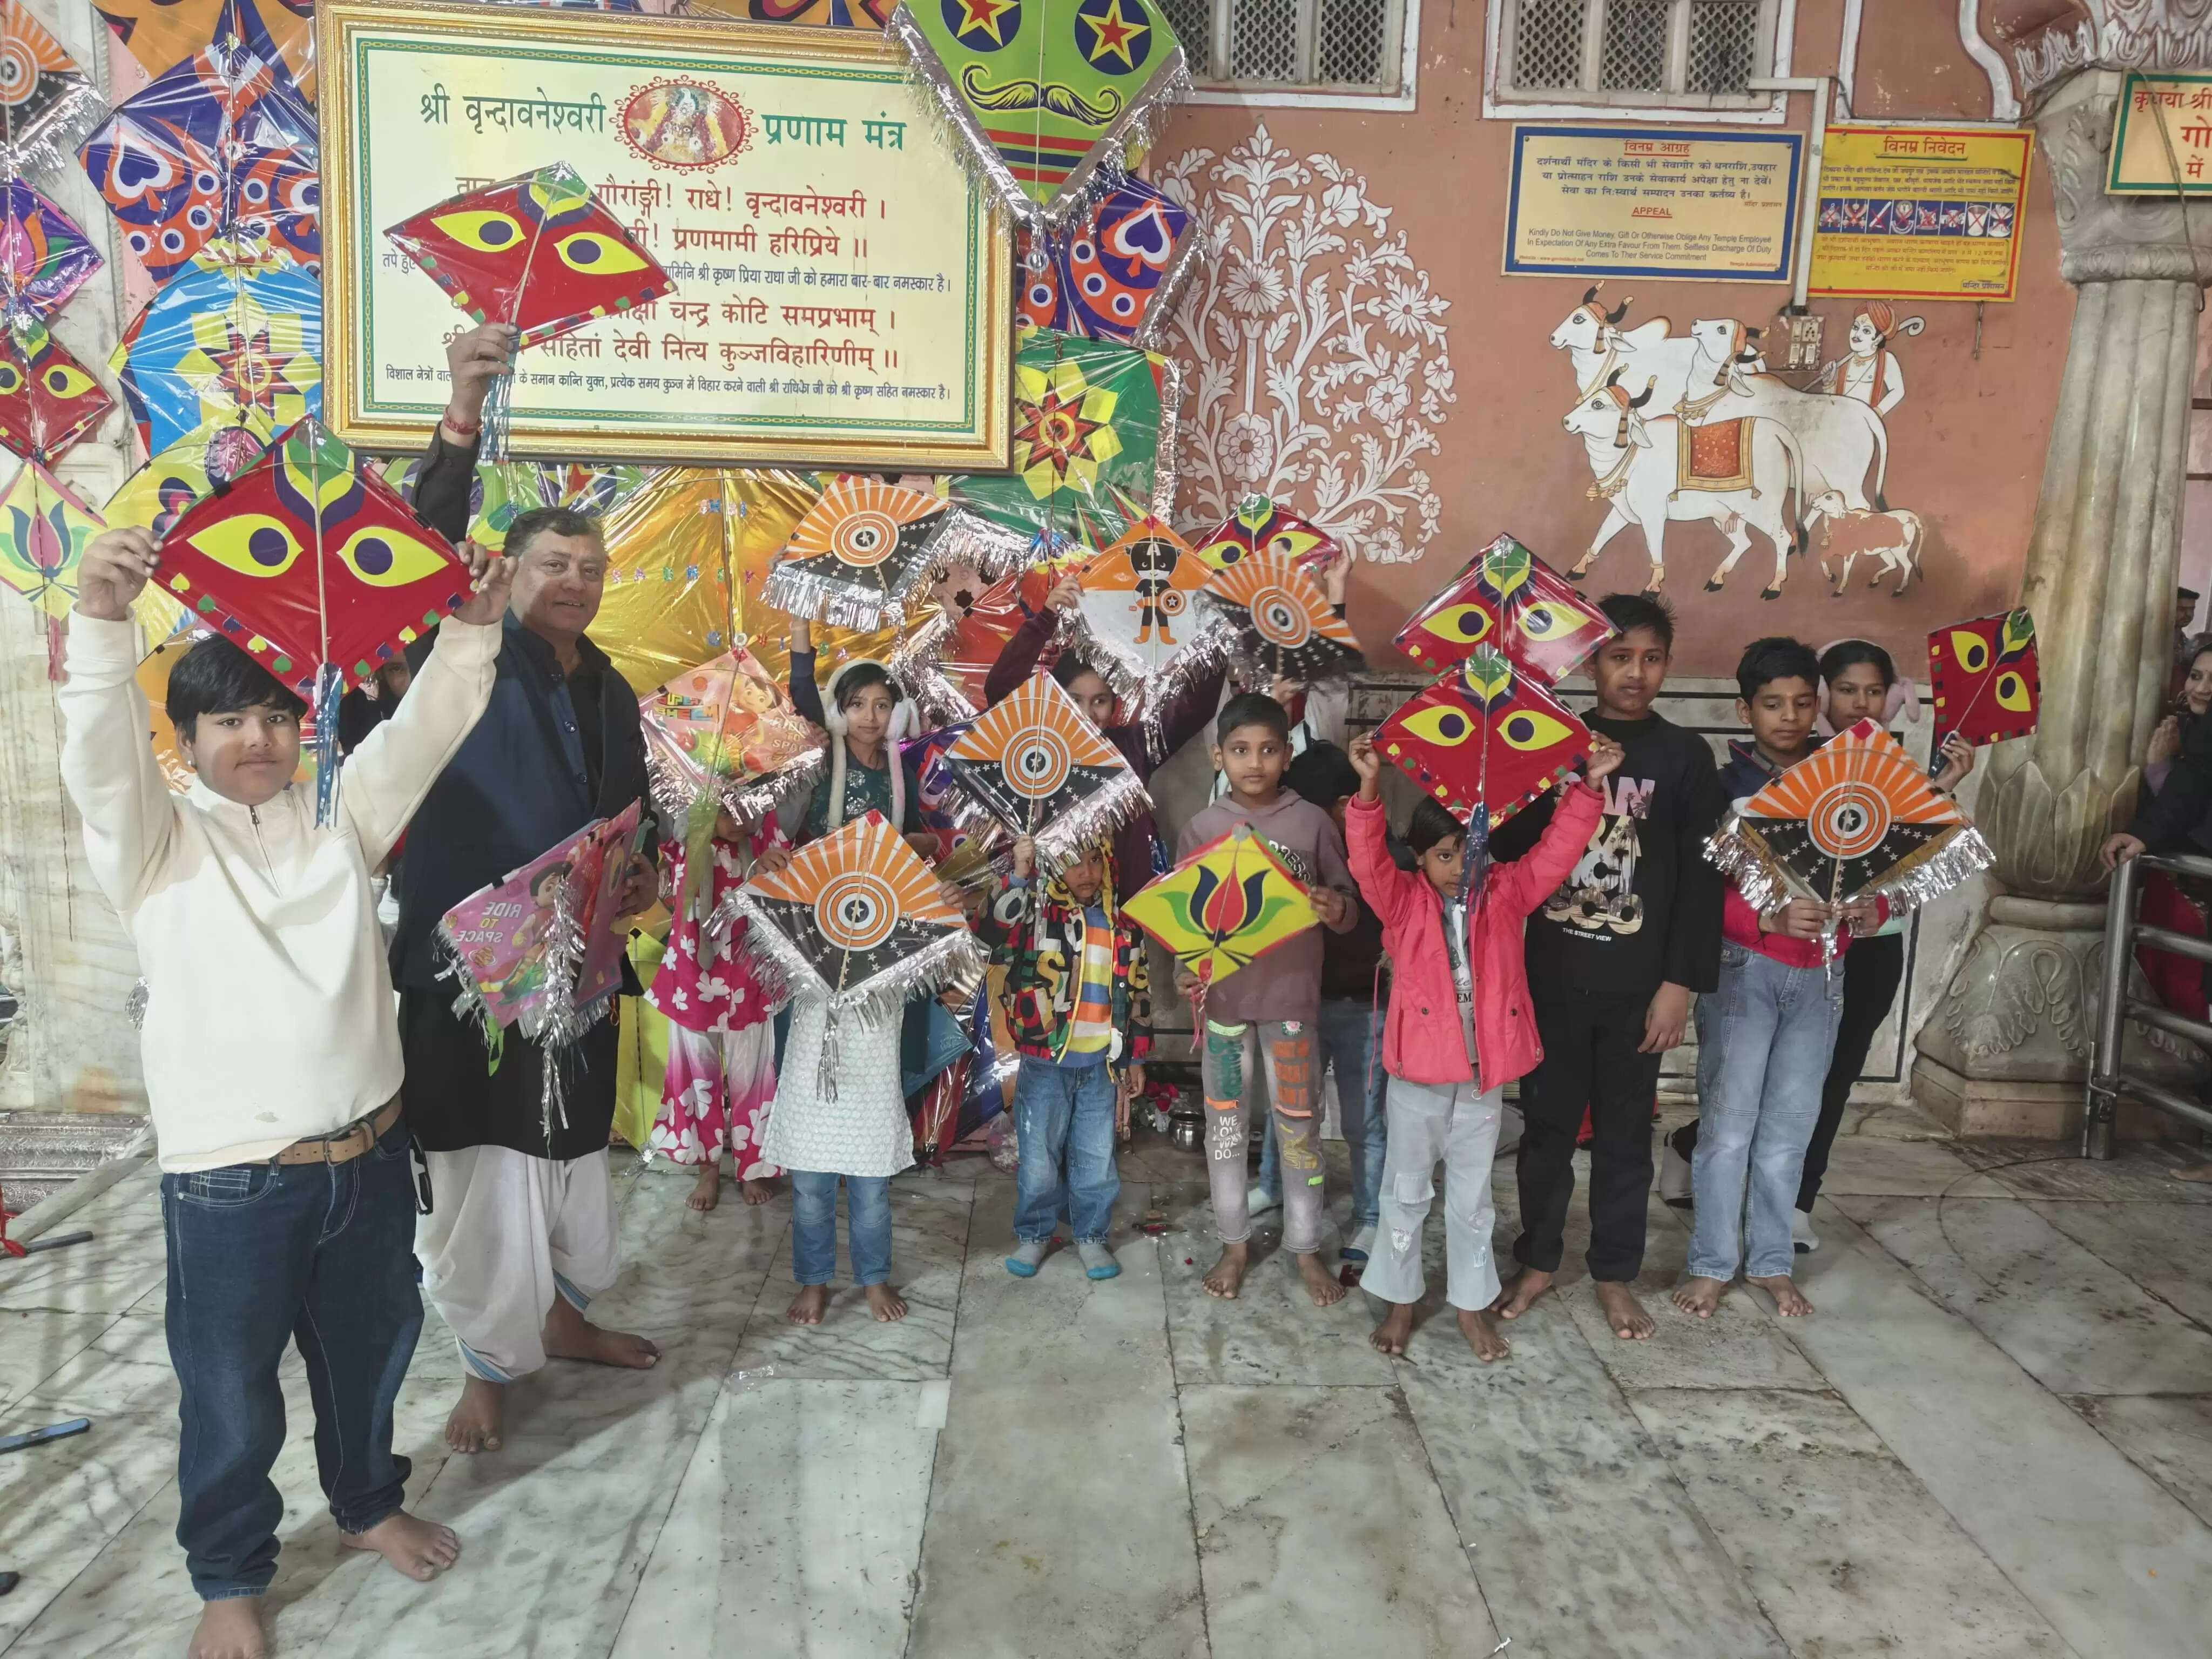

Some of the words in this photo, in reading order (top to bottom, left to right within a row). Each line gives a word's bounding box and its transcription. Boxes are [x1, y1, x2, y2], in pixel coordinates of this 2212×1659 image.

[421, 83, 450, 124] श्री
[463, 87, 606, 134] वृन्दावनेश्वरी
[761, 114, 848, 147] प्रणाम
[861, 111, 907, 151] मंत्र
[1624, 140, 1653, 151] विनम्र
[1661, 143, 1690, 153] आग्रह
[1883, 136, 1919, 153] विनम्र
[1923, 137, 1966, 156] निवेदन
[1598, 172, 1617, 181] राशि
[745, 185, 867, 219] वृन्दावनेश्वरी
[1633, 207, 1671, 215] APPEAL
[768, 226, 840, 258] हरिप्रिये
[1529, 228, 1549, 238] Kindly
[1576, 229, 1591, 237] Give
[1641, 232, 1674, 240] Otherwise
[1676, 233, 1697, 242] Oblige
[1698, 233, 1711, 242] Any
[1714, 234, 1737, 244] Temple
[1739, 235, 1772, 245] Employee
[1535, 239, 1573, 248] Expectation
[1584, 240, 1597, 248] Any
[1618, 241, 1641, 249] Favour
[1643, 241, 1660, 249] From
[1684, 243, 1709, 251] Selfless
[1712, 244, 1744, 254] Discharge
[1756, 245, 1772, 254] Duty
[1586, 250, 1609, 258] Comes
[1621, 251, 1637, 259] Their
[1640, 252, 1663, 260] Service
[1665, 252, 1707, 261] Commitment
[698, 262, 710, 281] श्री
[713, 268, 736, 286] कृष्ण
[739, 264, 761, 283] प्रिया
[764, 270, 784, 284] राधा
[787, 267, 800, 285] जी
[804, 267, 817, 286] को
[820, 273, 848, 287] हमारा
[893, 276, 934, 291] नमस्कार
[669, 301, 710, 327] चन्द्र
[721, 294, 768, 324] कोटि
[780, 306, 879, 336] समप्रभाम्
[613, 329, 650, 362] देवी
[662, 334, 708, 361] नित्य
[386, 364, 413, 380] विशाल
[530, 375, 555, 385] समान
[610, 373, 635, 388] प्रत्येक
[638, 378, 660, 389] समय
[686, 375, 694, 390] में
[698, 375, 721, 392] विहार
[724, 376, 744, 392] करने
[746, 378, 766, 393] वाली
[769, 379, 779, 393] श्री
[813, 380, 824, 395] जी
[826, 380, 837, 395] को
[841, 381, 851, 396] श्री
[876, 382, 898, 397] सहित
[901, 387, 936, 399] नमस्कार
[1574, 930, 1595, 939] STREET
